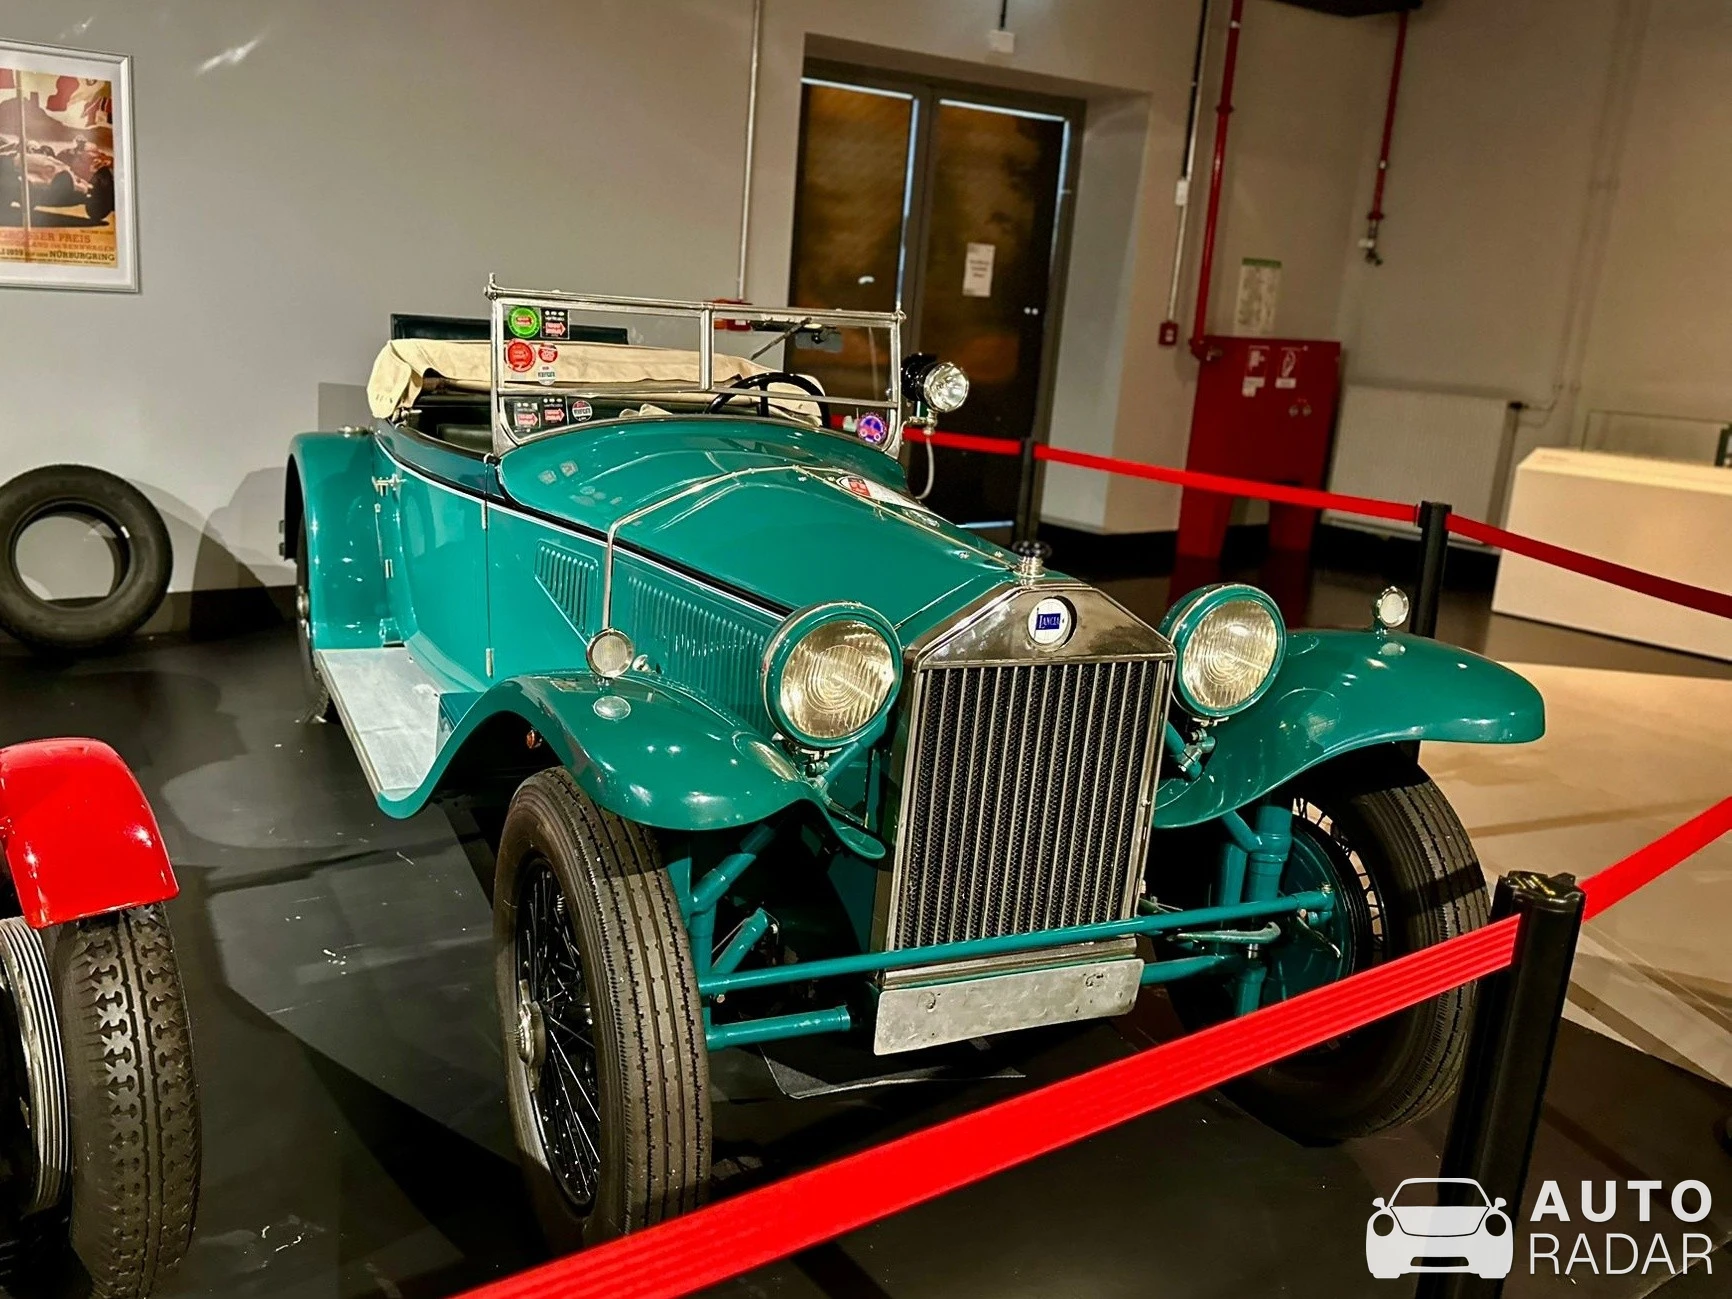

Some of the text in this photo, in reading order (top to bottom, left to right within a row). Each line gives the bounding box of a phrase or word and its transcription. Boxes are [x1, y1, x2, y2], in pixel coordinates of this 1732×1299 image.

[58, 232, 91, 244] PREIS
[49, 250, 115, 261] NÜRBURGRING
[1039, 614, 1060, 629] LANCIA
